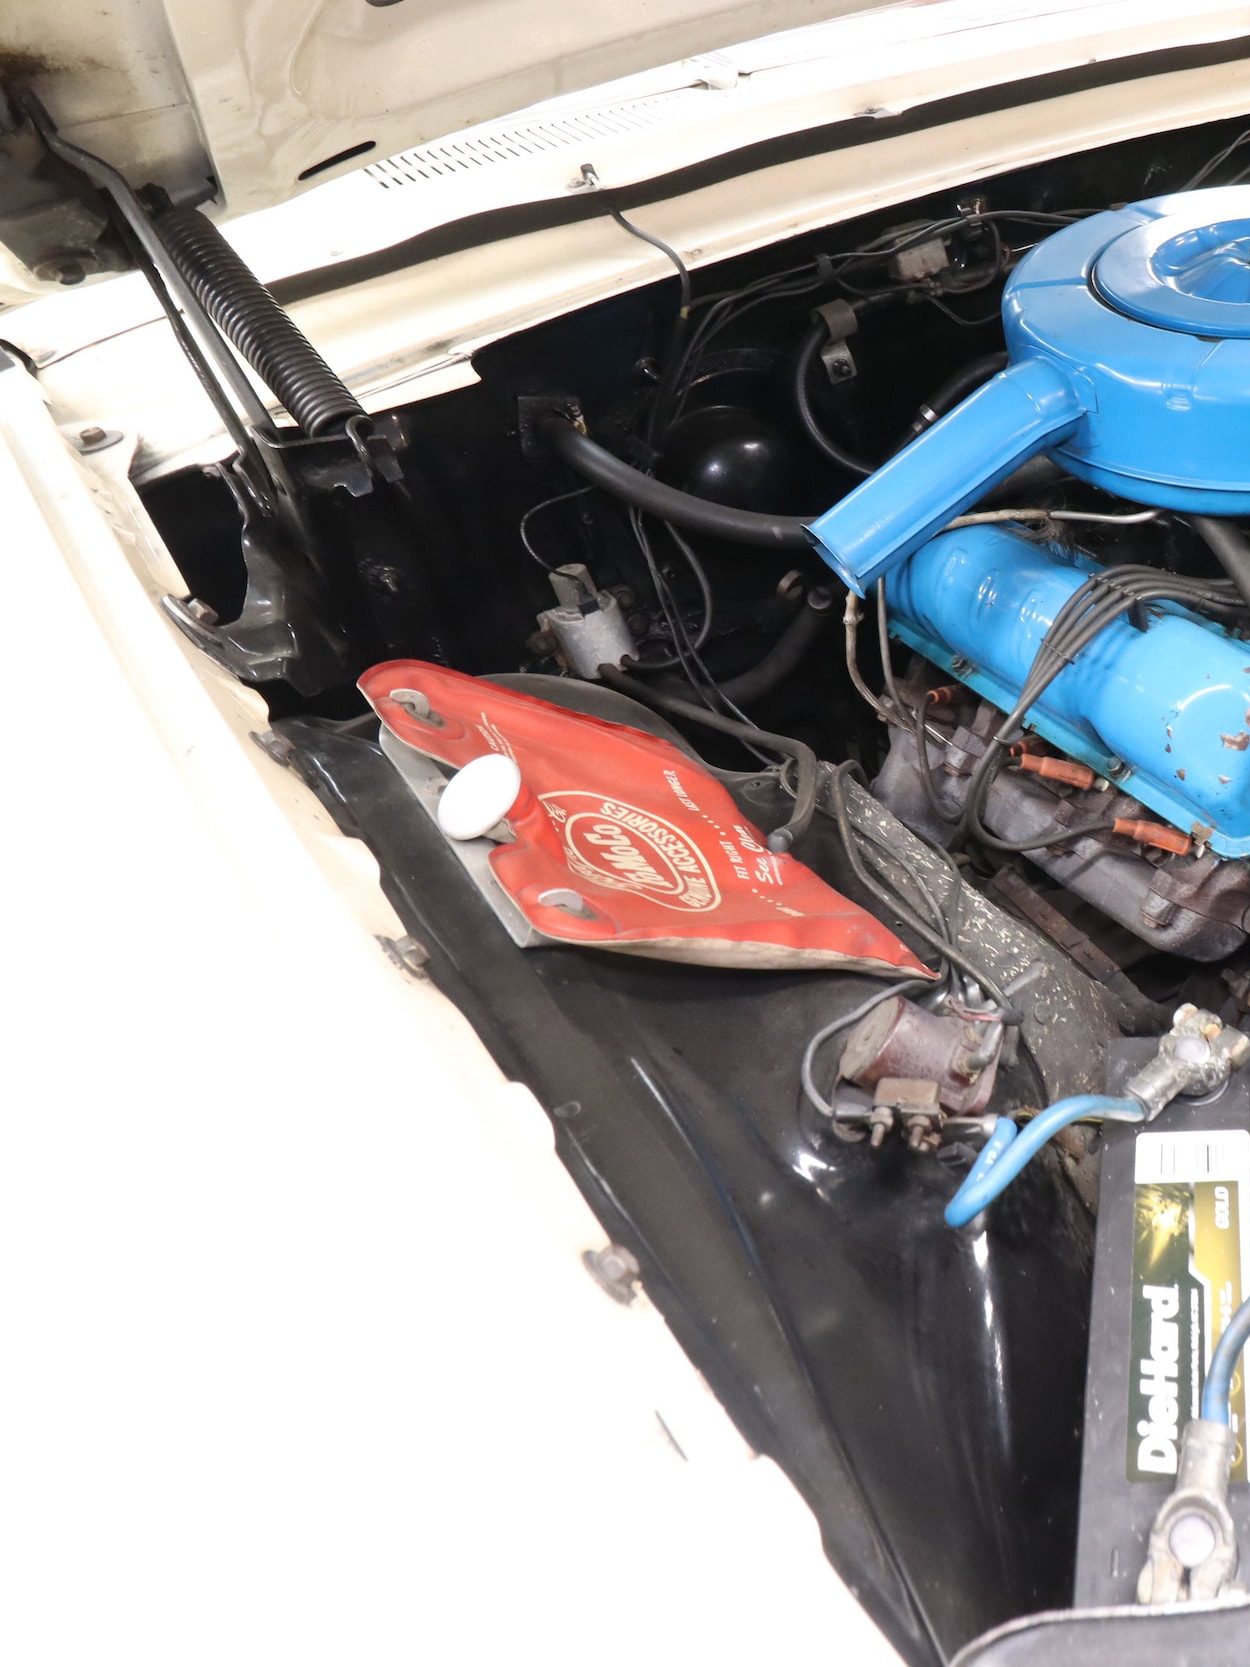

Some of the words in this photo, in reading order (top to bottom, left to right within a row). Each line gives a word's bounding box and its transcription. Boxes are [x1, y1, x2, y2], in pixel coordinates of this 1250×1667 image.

[583, 823, 675, 889] FoMoCo
[600, 801, 702, 874] ACCESSORIES
[719, 840, 744, 864] RIGHT
[733, 865, 750, 880] FIT
[1214, 1185, 1230, 1230] GOLD
[1136, 1283, 1180, 1475] DieHard
